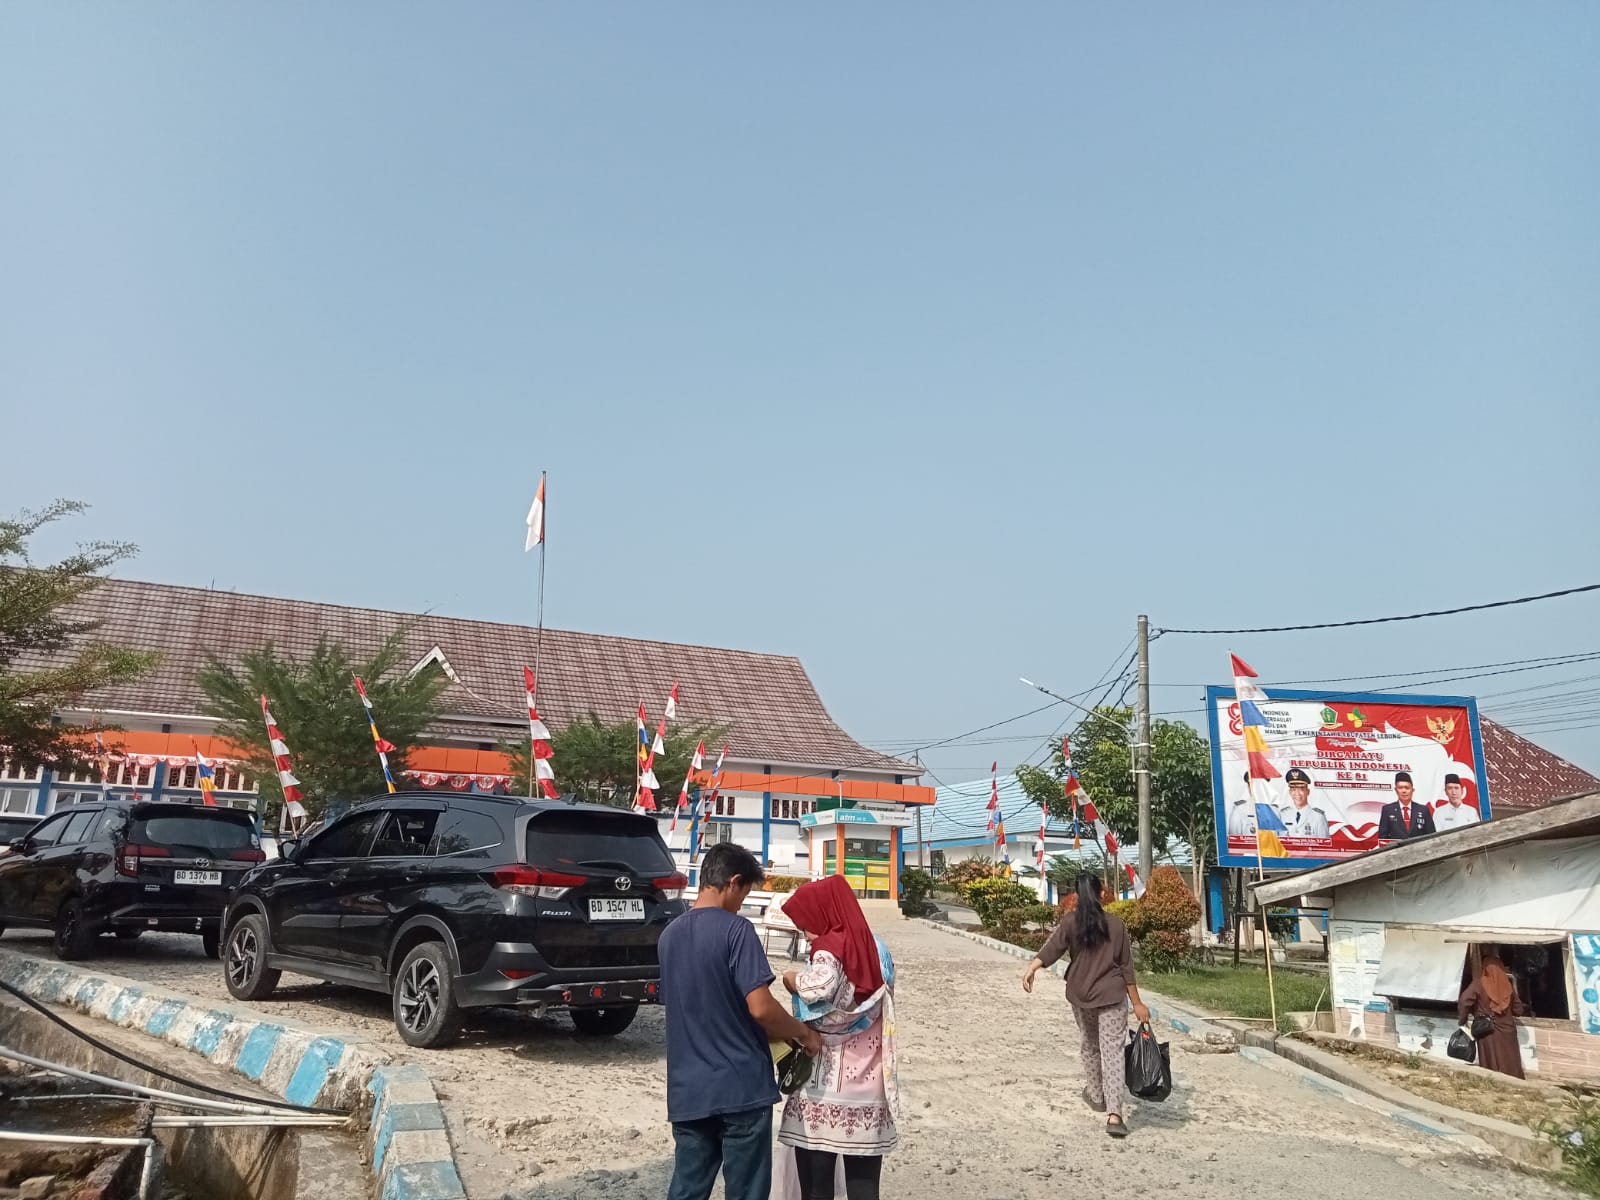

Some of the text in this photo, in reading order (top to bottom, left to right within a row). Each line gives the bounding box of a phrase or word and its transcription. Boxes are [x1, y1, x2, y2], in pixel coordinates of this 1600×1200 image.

[1316, 751, 1384, 760] DIRGAHAYU
[1290, 760, 1412, 771] REPUBLIK INDONESIA
[1336, 771, 1352, 780] KE
[189, 872, 207, 880] 1376
[591, 901, 642, 912] BD 1547 HL
